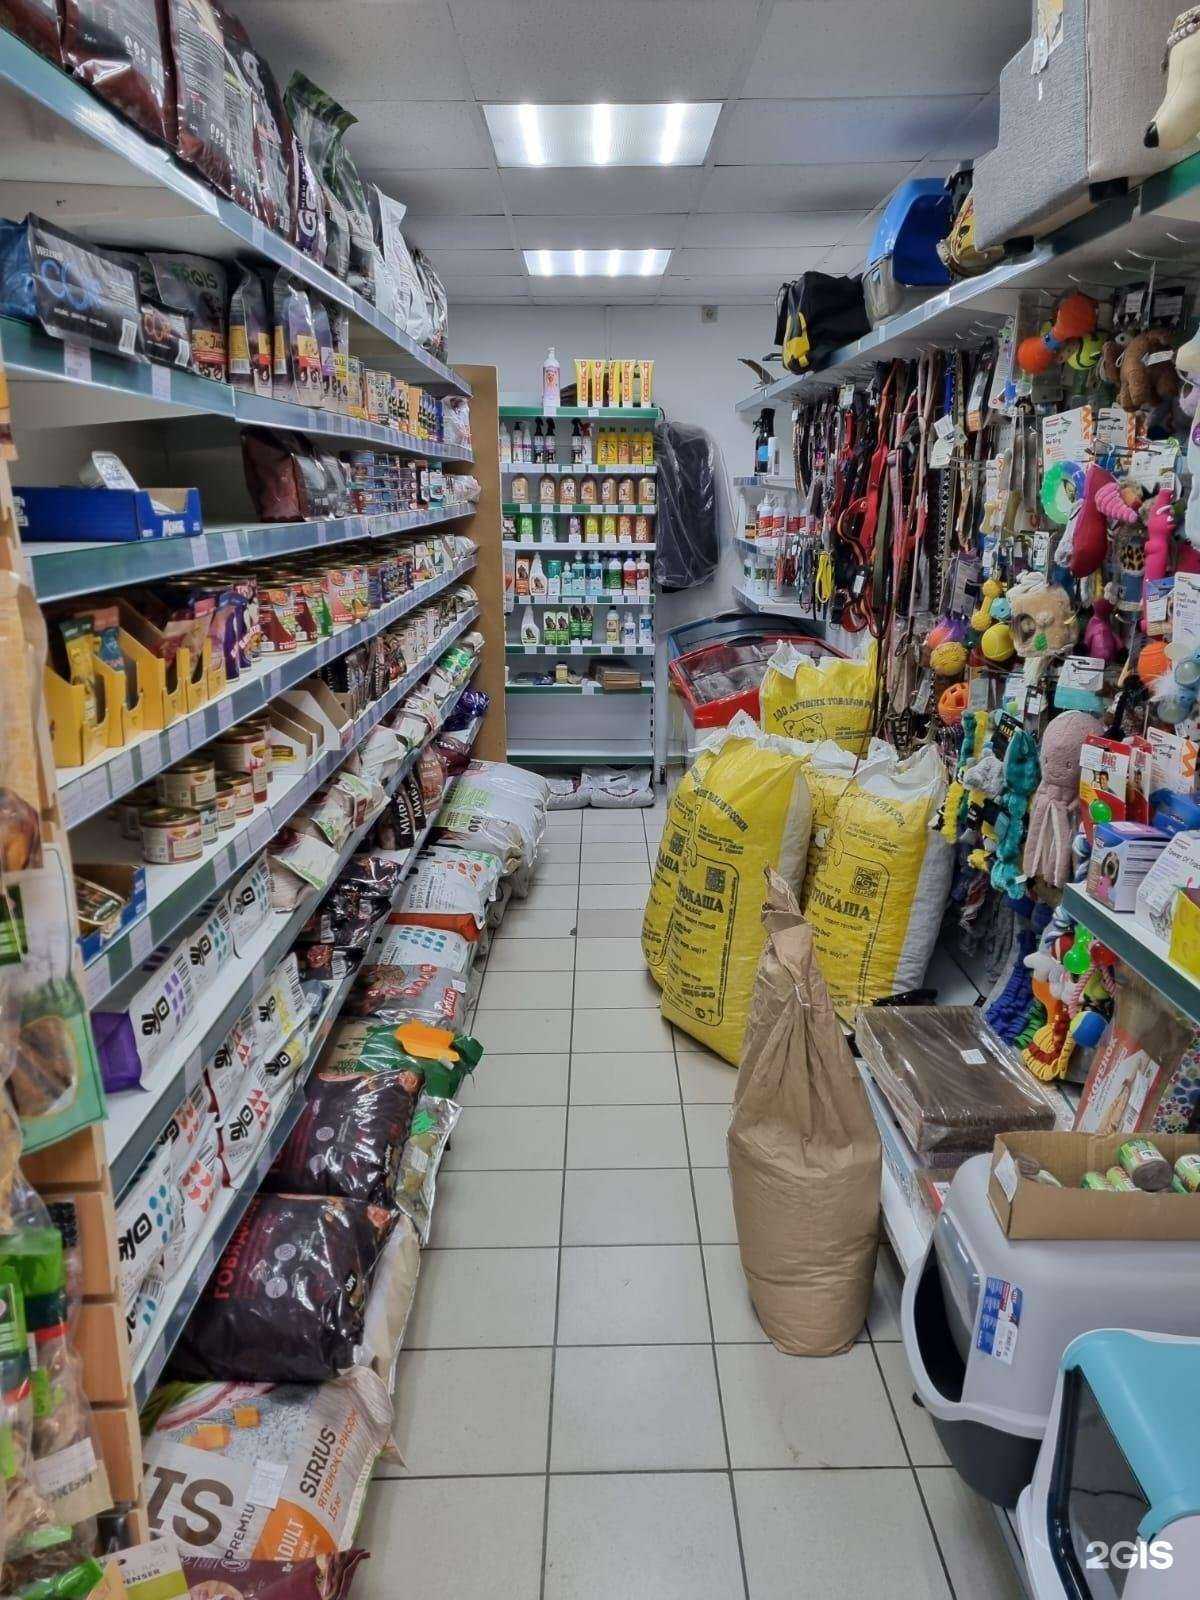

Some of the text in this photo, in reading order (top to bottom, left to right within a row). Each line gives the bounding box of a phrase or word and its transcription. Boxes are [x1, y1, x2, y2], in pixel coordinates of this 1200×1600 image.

[773, 706, 788, 721] 100
[300, 1428, 336, 1498] SIRIUS
[317, 1456, 341, 1510] ЯГНЕНОК
[143, 1463, 234, 1547] TS
[225, 1504, 256, 1560] PREMIU
[327, 1504, 338, 1522] 15
